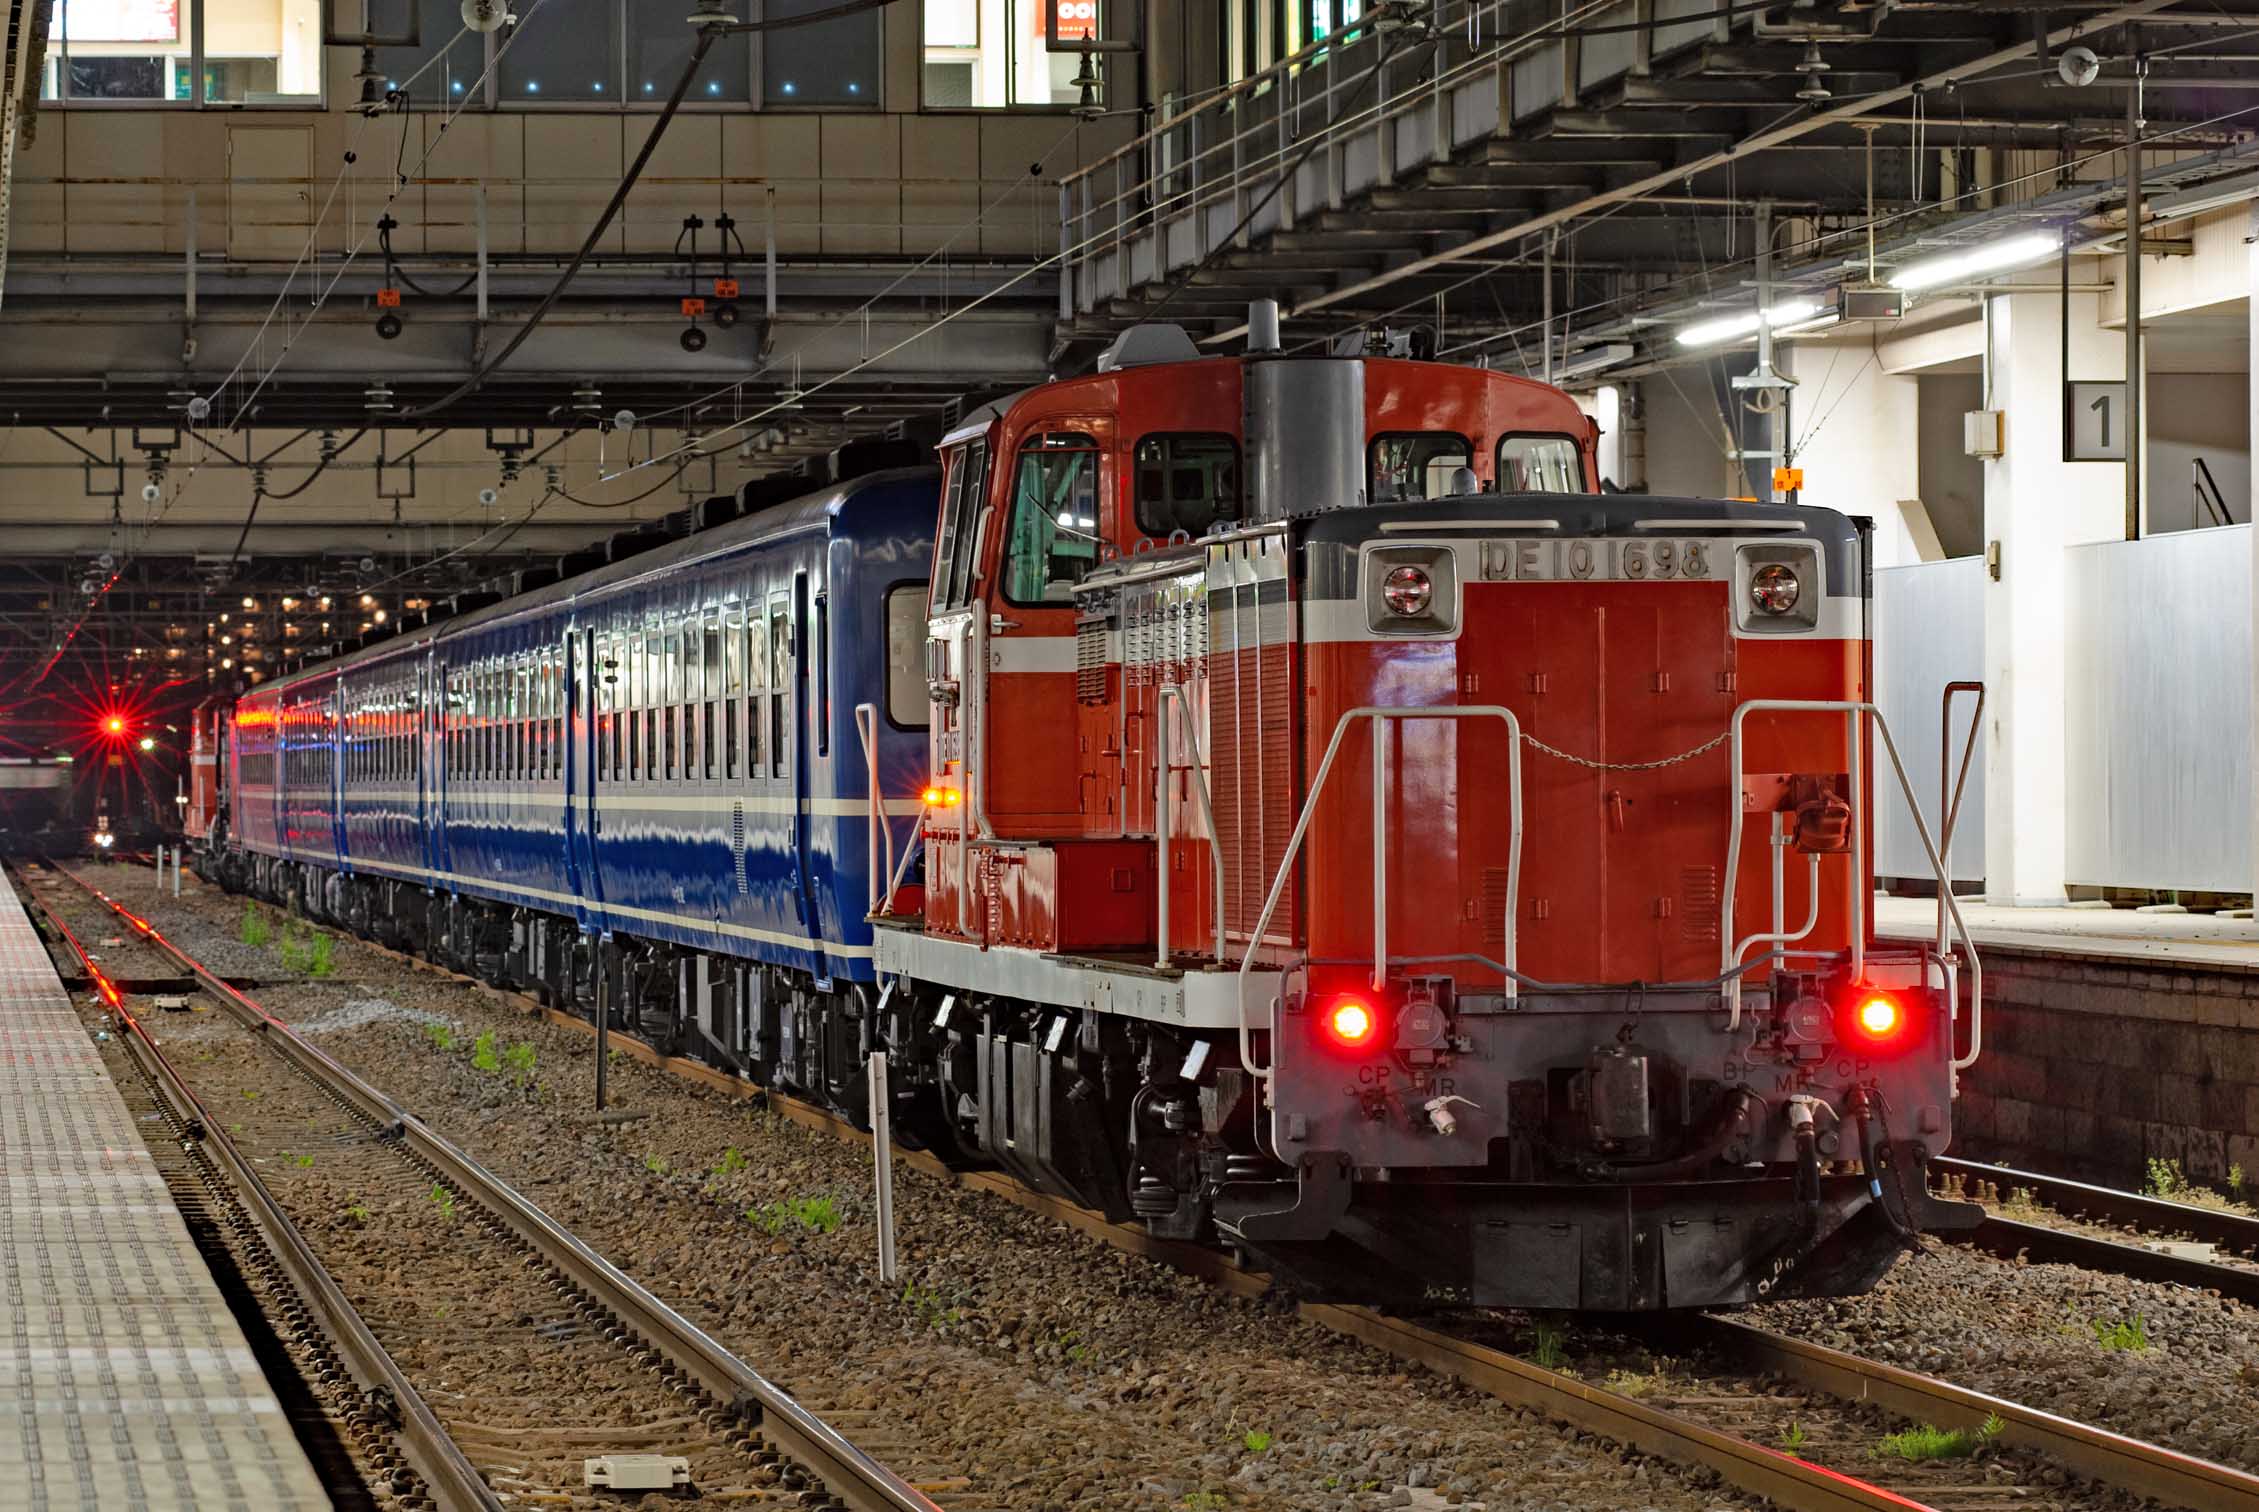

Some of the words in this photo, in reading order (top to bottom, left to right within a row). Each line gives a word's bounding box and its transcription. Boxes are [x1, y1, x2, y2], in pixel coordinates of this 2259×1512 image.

[2091, 395, 2110, 447] 1
[1358, 1065, 1390, 1085] CP
[1837, 1059, 1870, 1078] CP
[1421, 1077, 1456, 1097] MR
